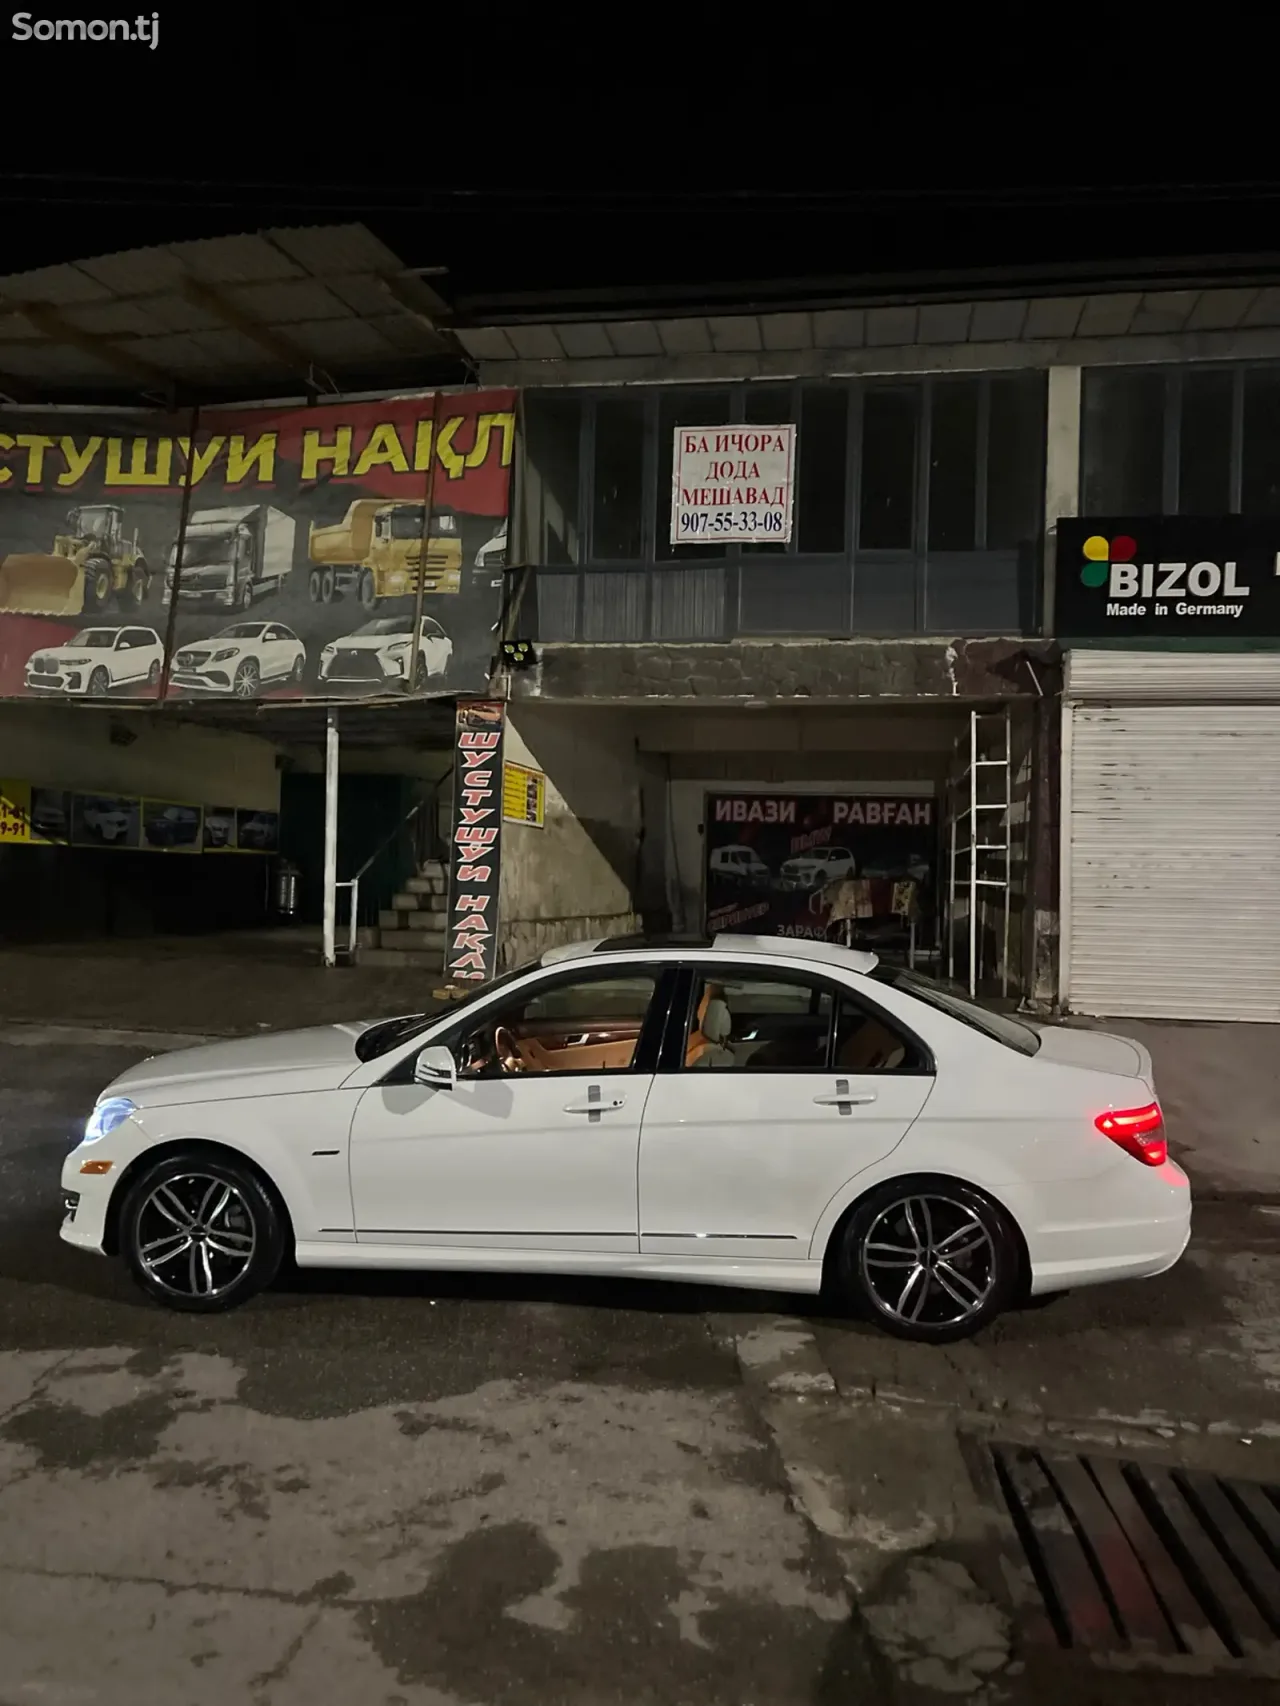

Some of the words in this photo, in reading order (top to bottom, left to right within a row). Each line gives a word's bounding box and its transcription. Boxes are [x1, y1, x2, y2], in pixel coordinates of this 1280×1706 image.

[685, 435, 709, 453] БА
[715, 434, 785, 455] ИҶОРА
[705, 461, 760, 482] ДОДА
[682, 487, 785, 508] МЕШАВАД
[681, 511, 783, 533] 907-55-33-08
[1109, 562, 1250, 597] BIZOL
[1106, 603, 1147, 616] Made
[1155, 603, 1168, 616] in
[1175, 602, 1244, 618] Germany
[715, 800, 796, 823] ИВАЗИ
[833, 802, 931, 825] РАВҒАН
